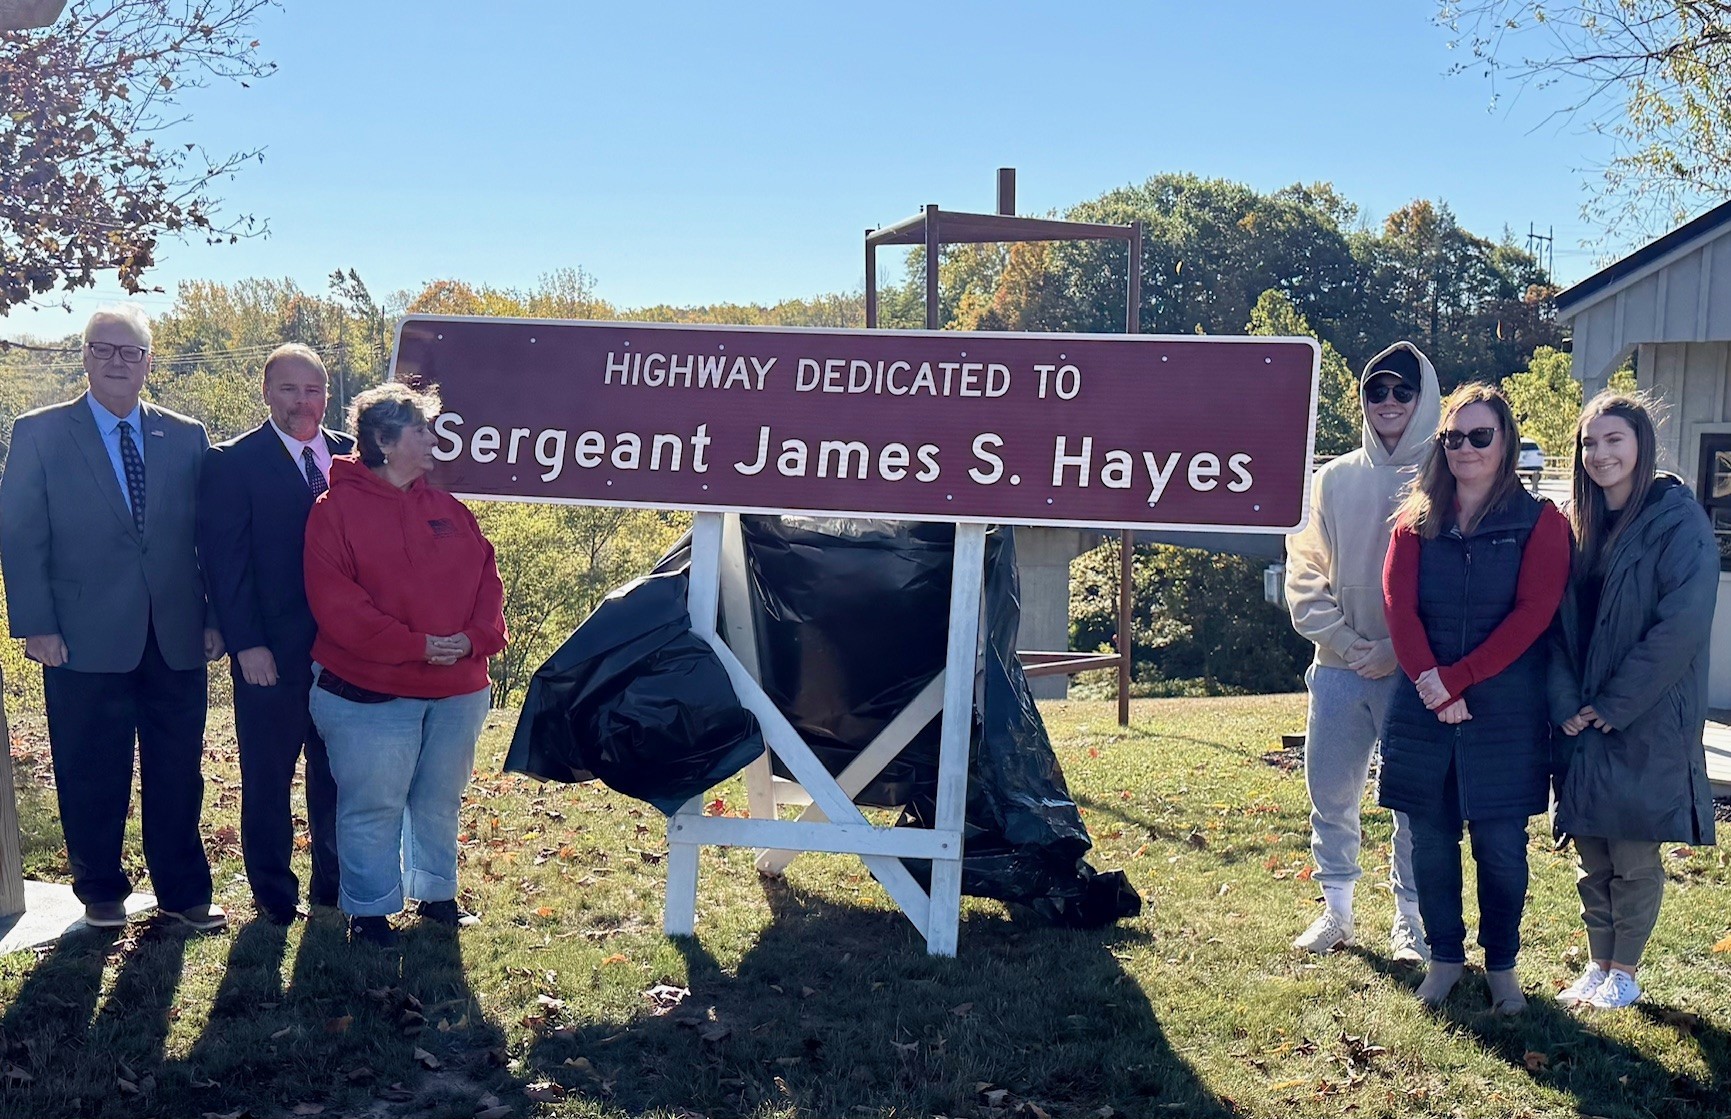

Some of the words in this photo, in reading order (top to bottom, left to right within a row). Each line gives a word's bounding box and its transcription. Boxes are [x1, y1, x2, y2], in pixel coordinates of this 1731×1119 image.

[604, 351, 778, 391] HIGHWAY
[795, 358, 1011, 398] DEDICATED
[1033, 364, 1081, 400] TO
[431, 412, 711, 483] Sergeant
[734, 425, 941, 483] James
[968, 432, 1021, 486] S.
[1052, 435, 1254, 504] Hayes
